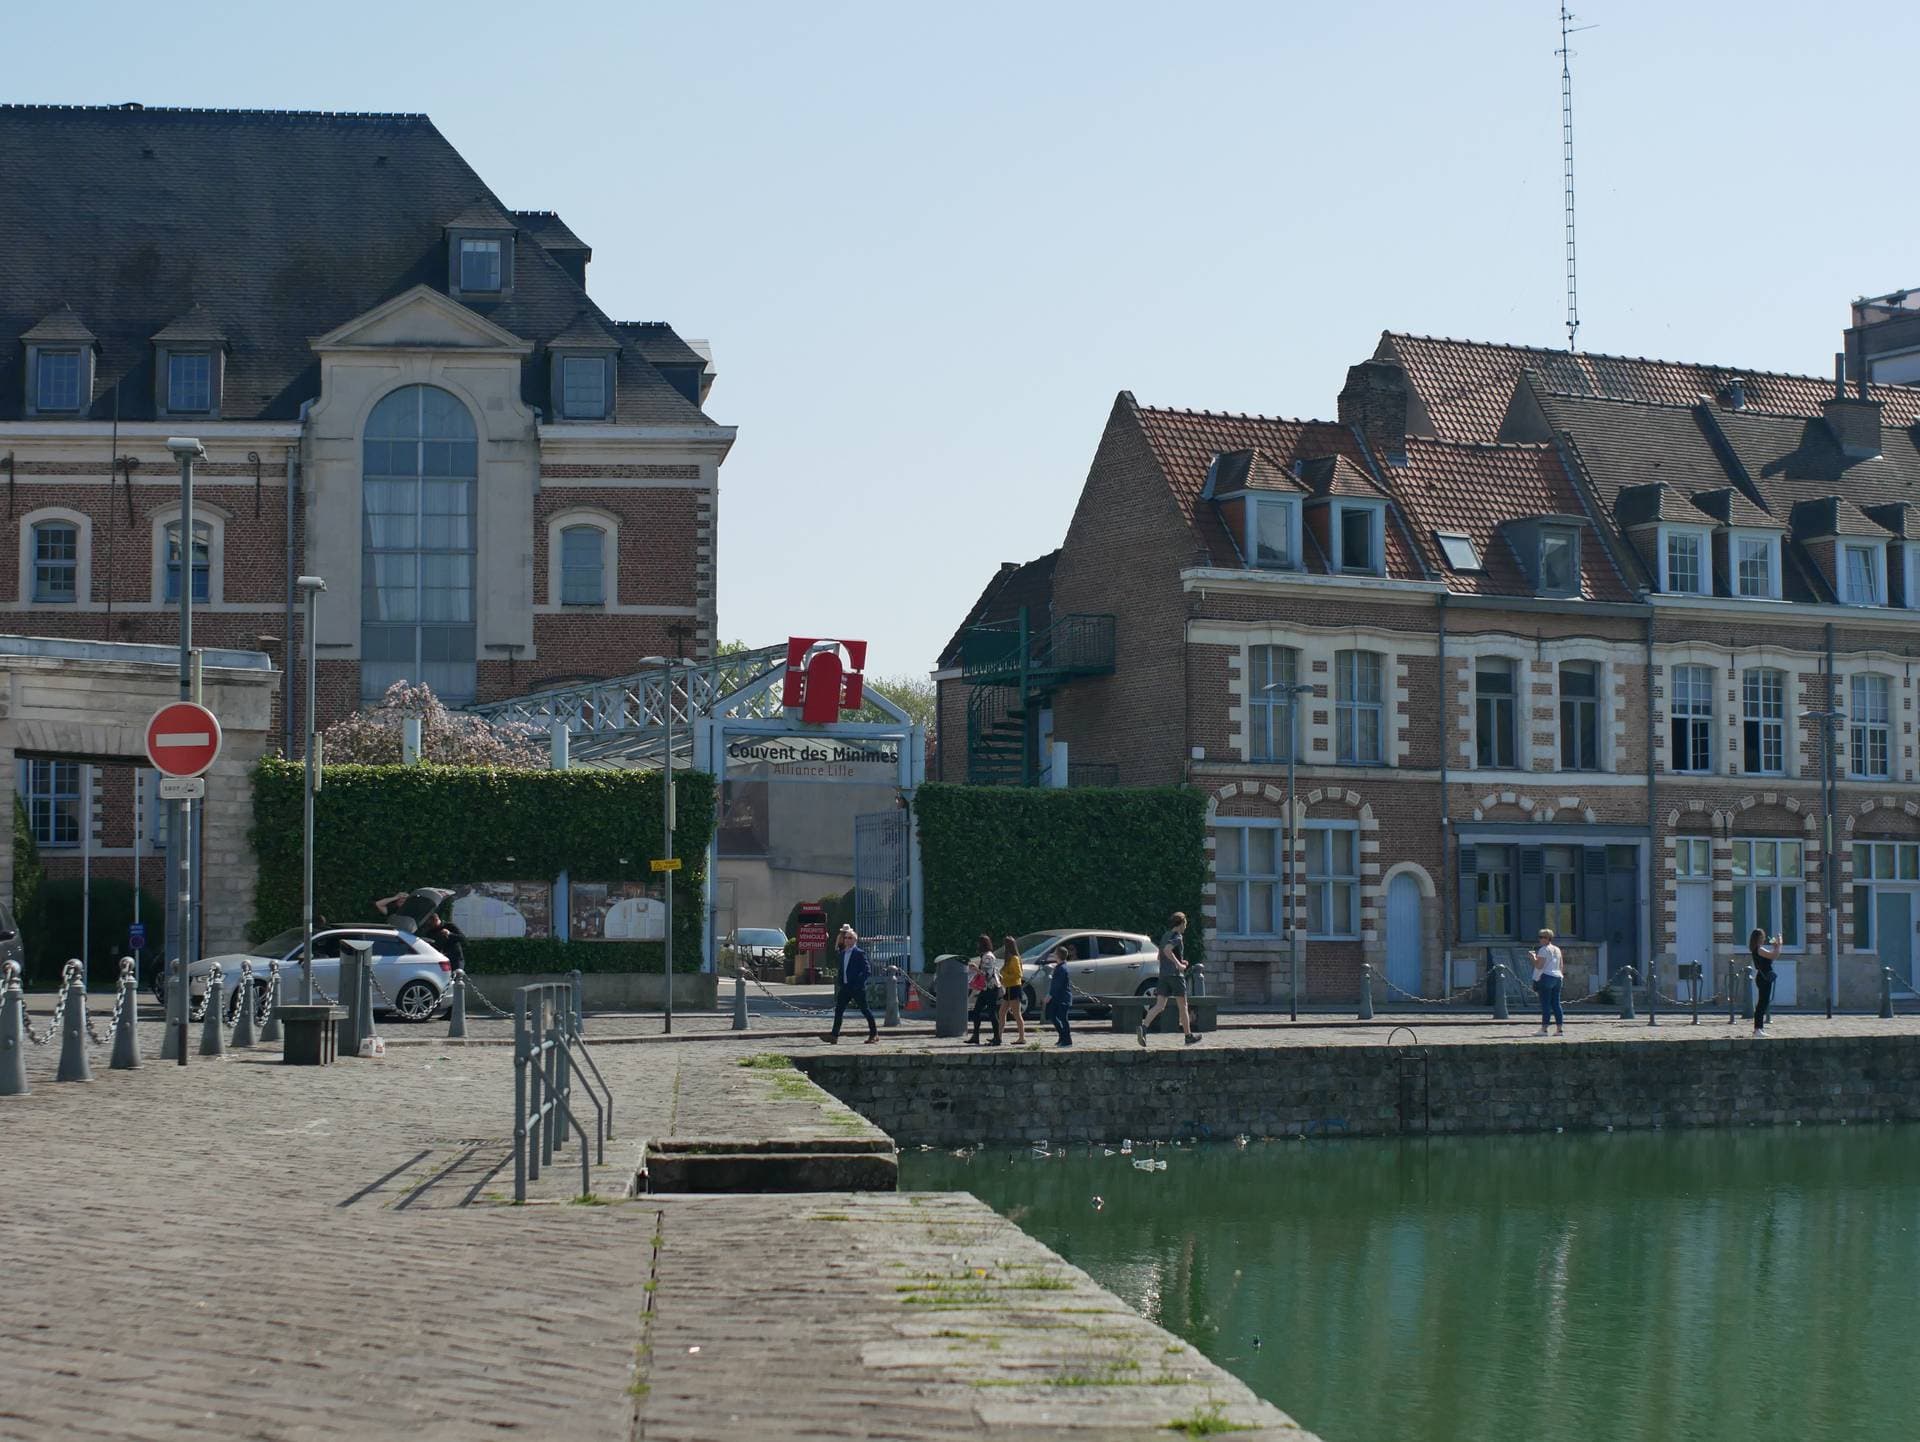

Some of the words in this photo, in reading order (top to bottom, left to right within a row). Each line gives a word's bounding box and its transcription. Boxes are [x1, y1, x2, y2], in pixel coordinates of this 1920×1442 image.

[728, 743, 795, 760] Couvent
[800, 746, 828, 762] des
[833, 747, 899, 764] Minimes
[774, 763, 824, 776] Alliance
[828, 765, 855, 776] Lille
